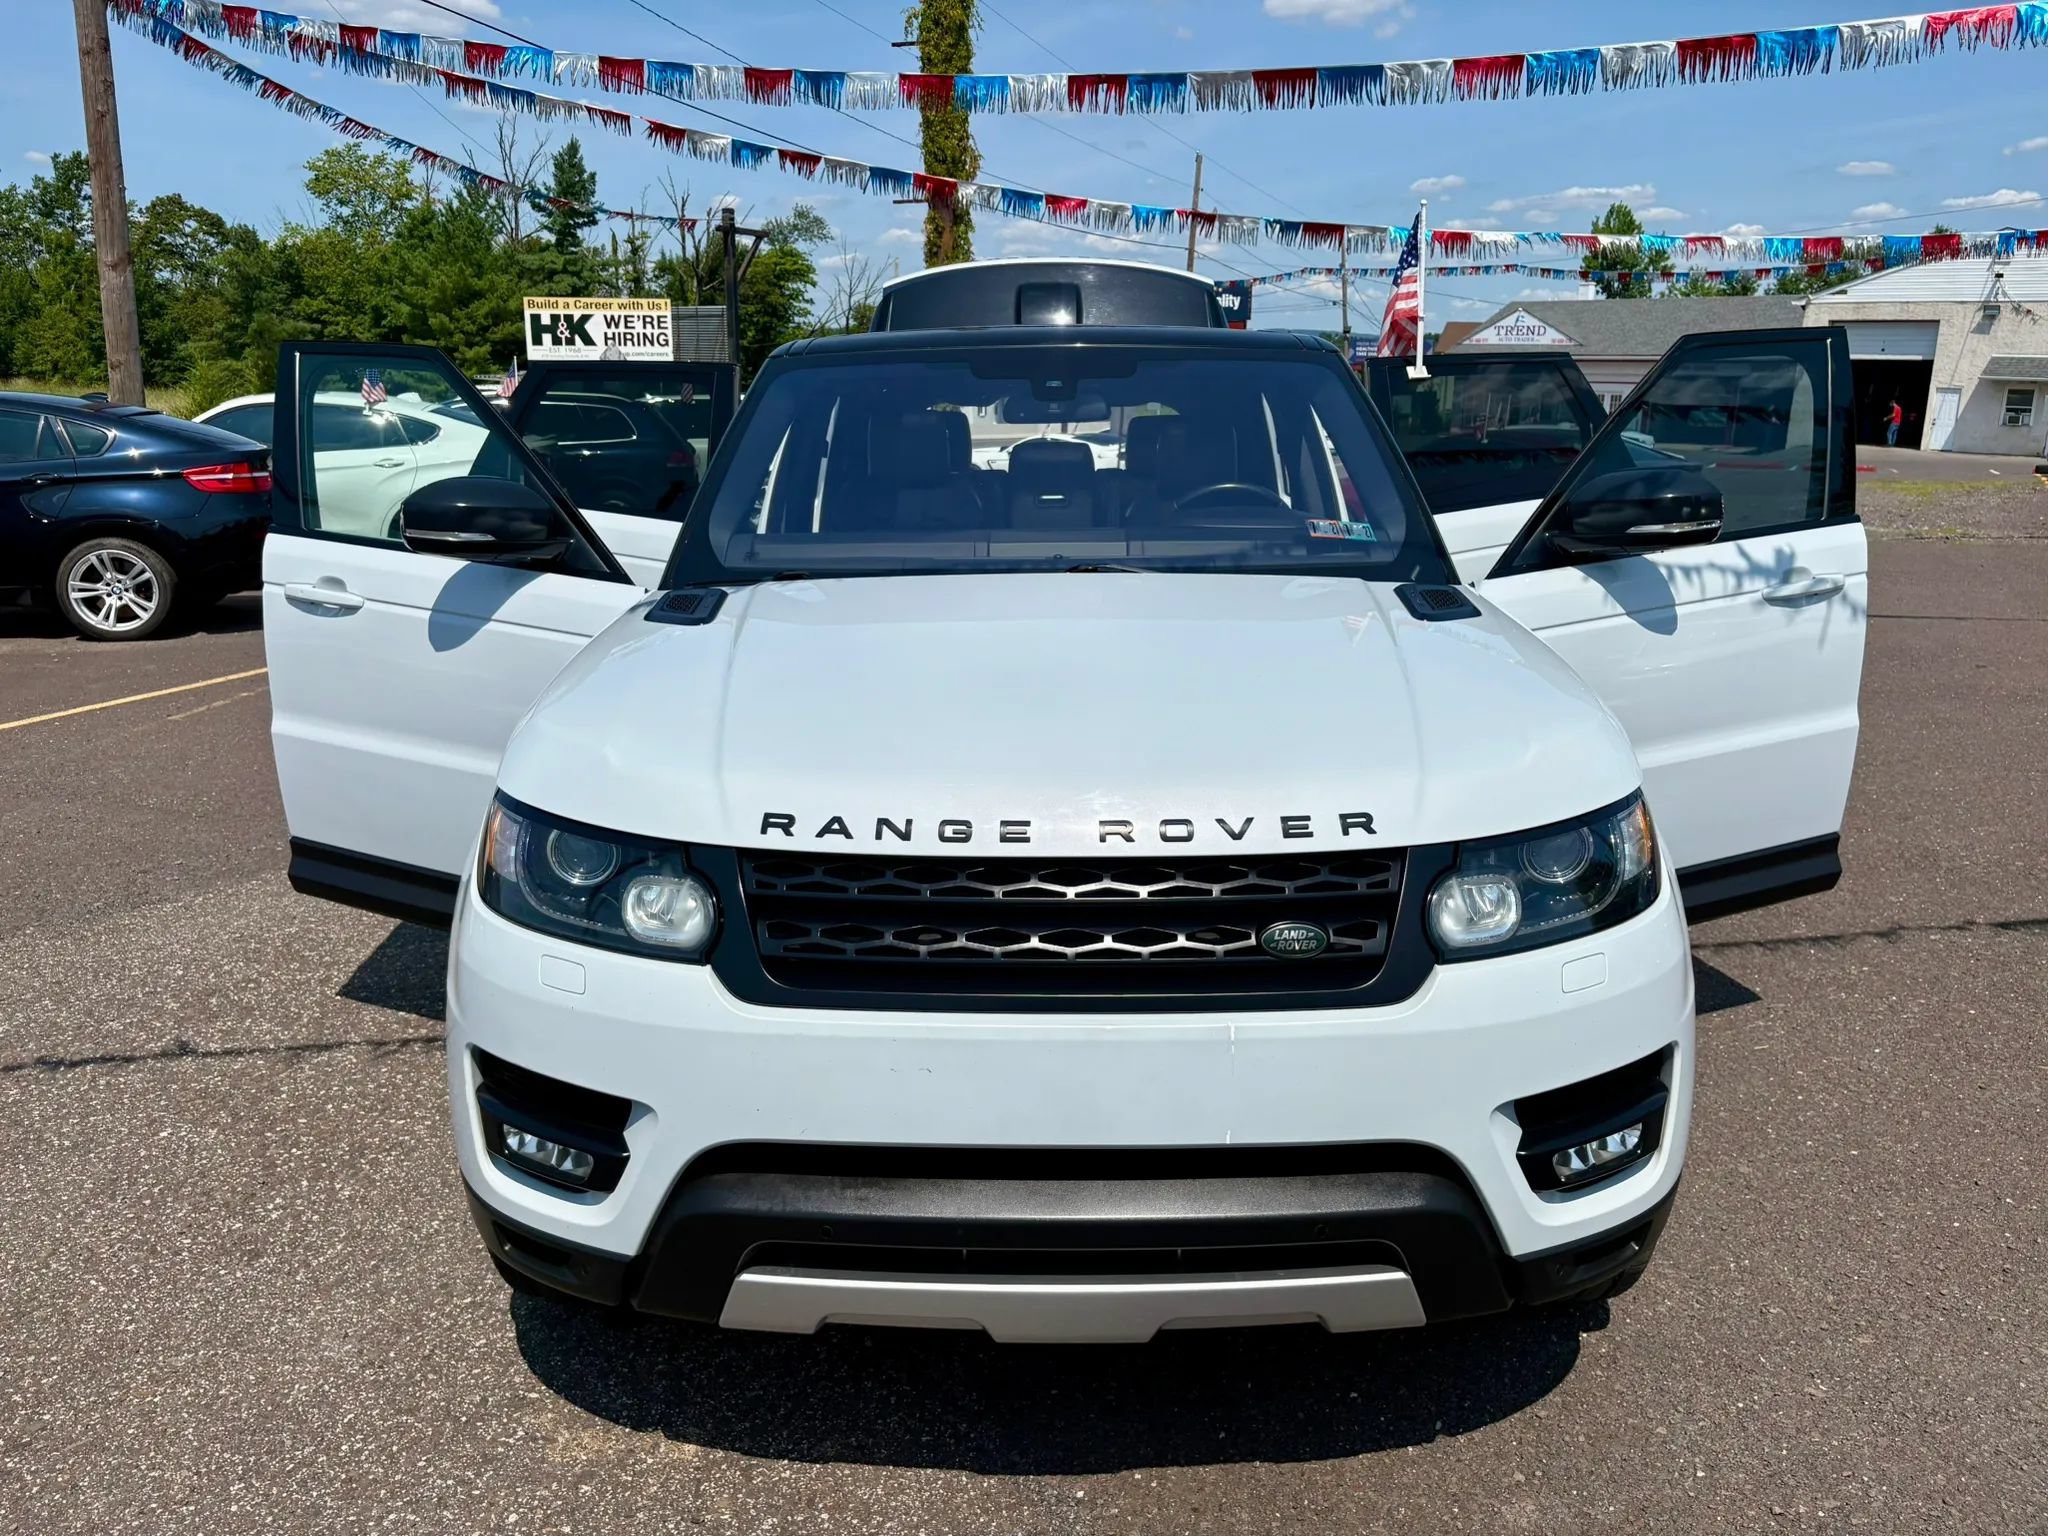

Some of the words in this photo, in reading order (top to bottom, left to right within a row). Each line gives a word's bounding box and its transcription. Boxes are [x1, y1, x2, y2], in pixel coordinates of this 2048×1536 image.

[527, 299, 559, 310] Build
[563, 302, 570, 310] a
[575, 299, 614, 310] Career
[618, 300, 644, 311] with
[603, 314, 669, 330] WE'RE
[529, 313, 598, 346] H&K
[1494, 325, 1547, 336] TREND
[603, 332, 669, 347] HIRING
[759, 811, 1032, 844] RANGE
[1096, 811, 1378, 844] ROVER
[1274, 930, 1307, 940] LAND
[1277, 940, 1317, 951] ROVER
